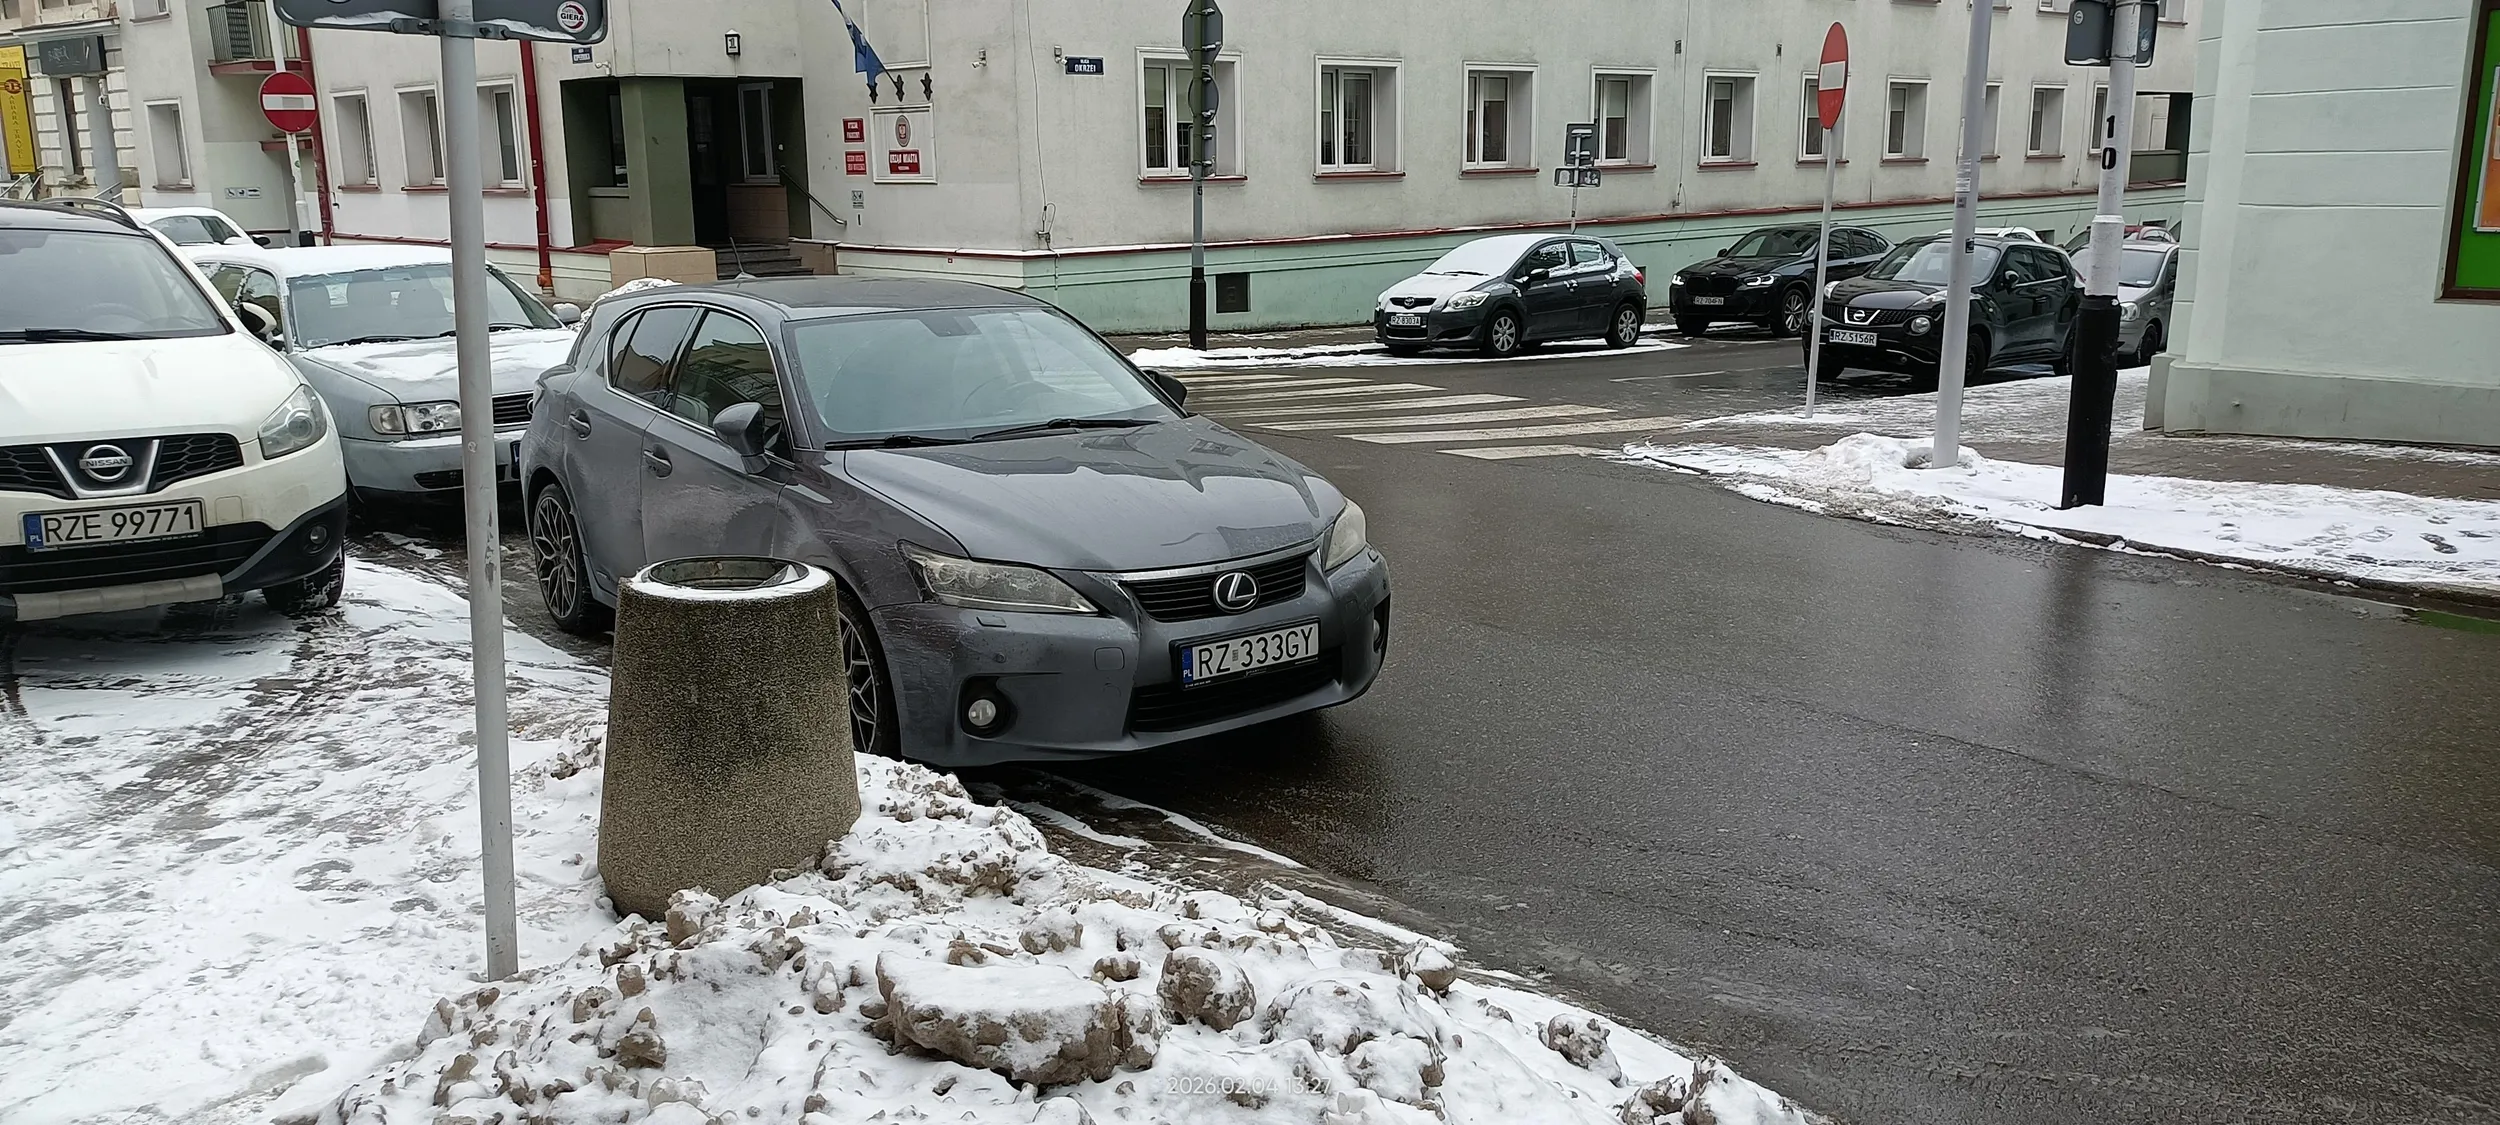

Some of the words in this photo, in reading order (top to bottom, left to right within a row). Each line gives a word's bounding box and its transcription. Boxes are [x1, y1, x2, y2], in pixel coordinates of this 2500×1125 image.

[560, 12, 584, 22] GIERA
[728, 37, 736, 48] 1
[1074, 64, 1096, 72] OKRZEI
[1835, 330, 1846, 341] RZ
[1848, 332, 1874, 344] 5156R
[86, 458, 127, 466] NISSAN
[44, 514, 102, 542] RZE
[111, 506, 194, 537] 99771
[1199, 644, 1230, 677] RZ
[1240, 627, 1313, 668] 333GY
[1183, 668, 1192, 678] PL
